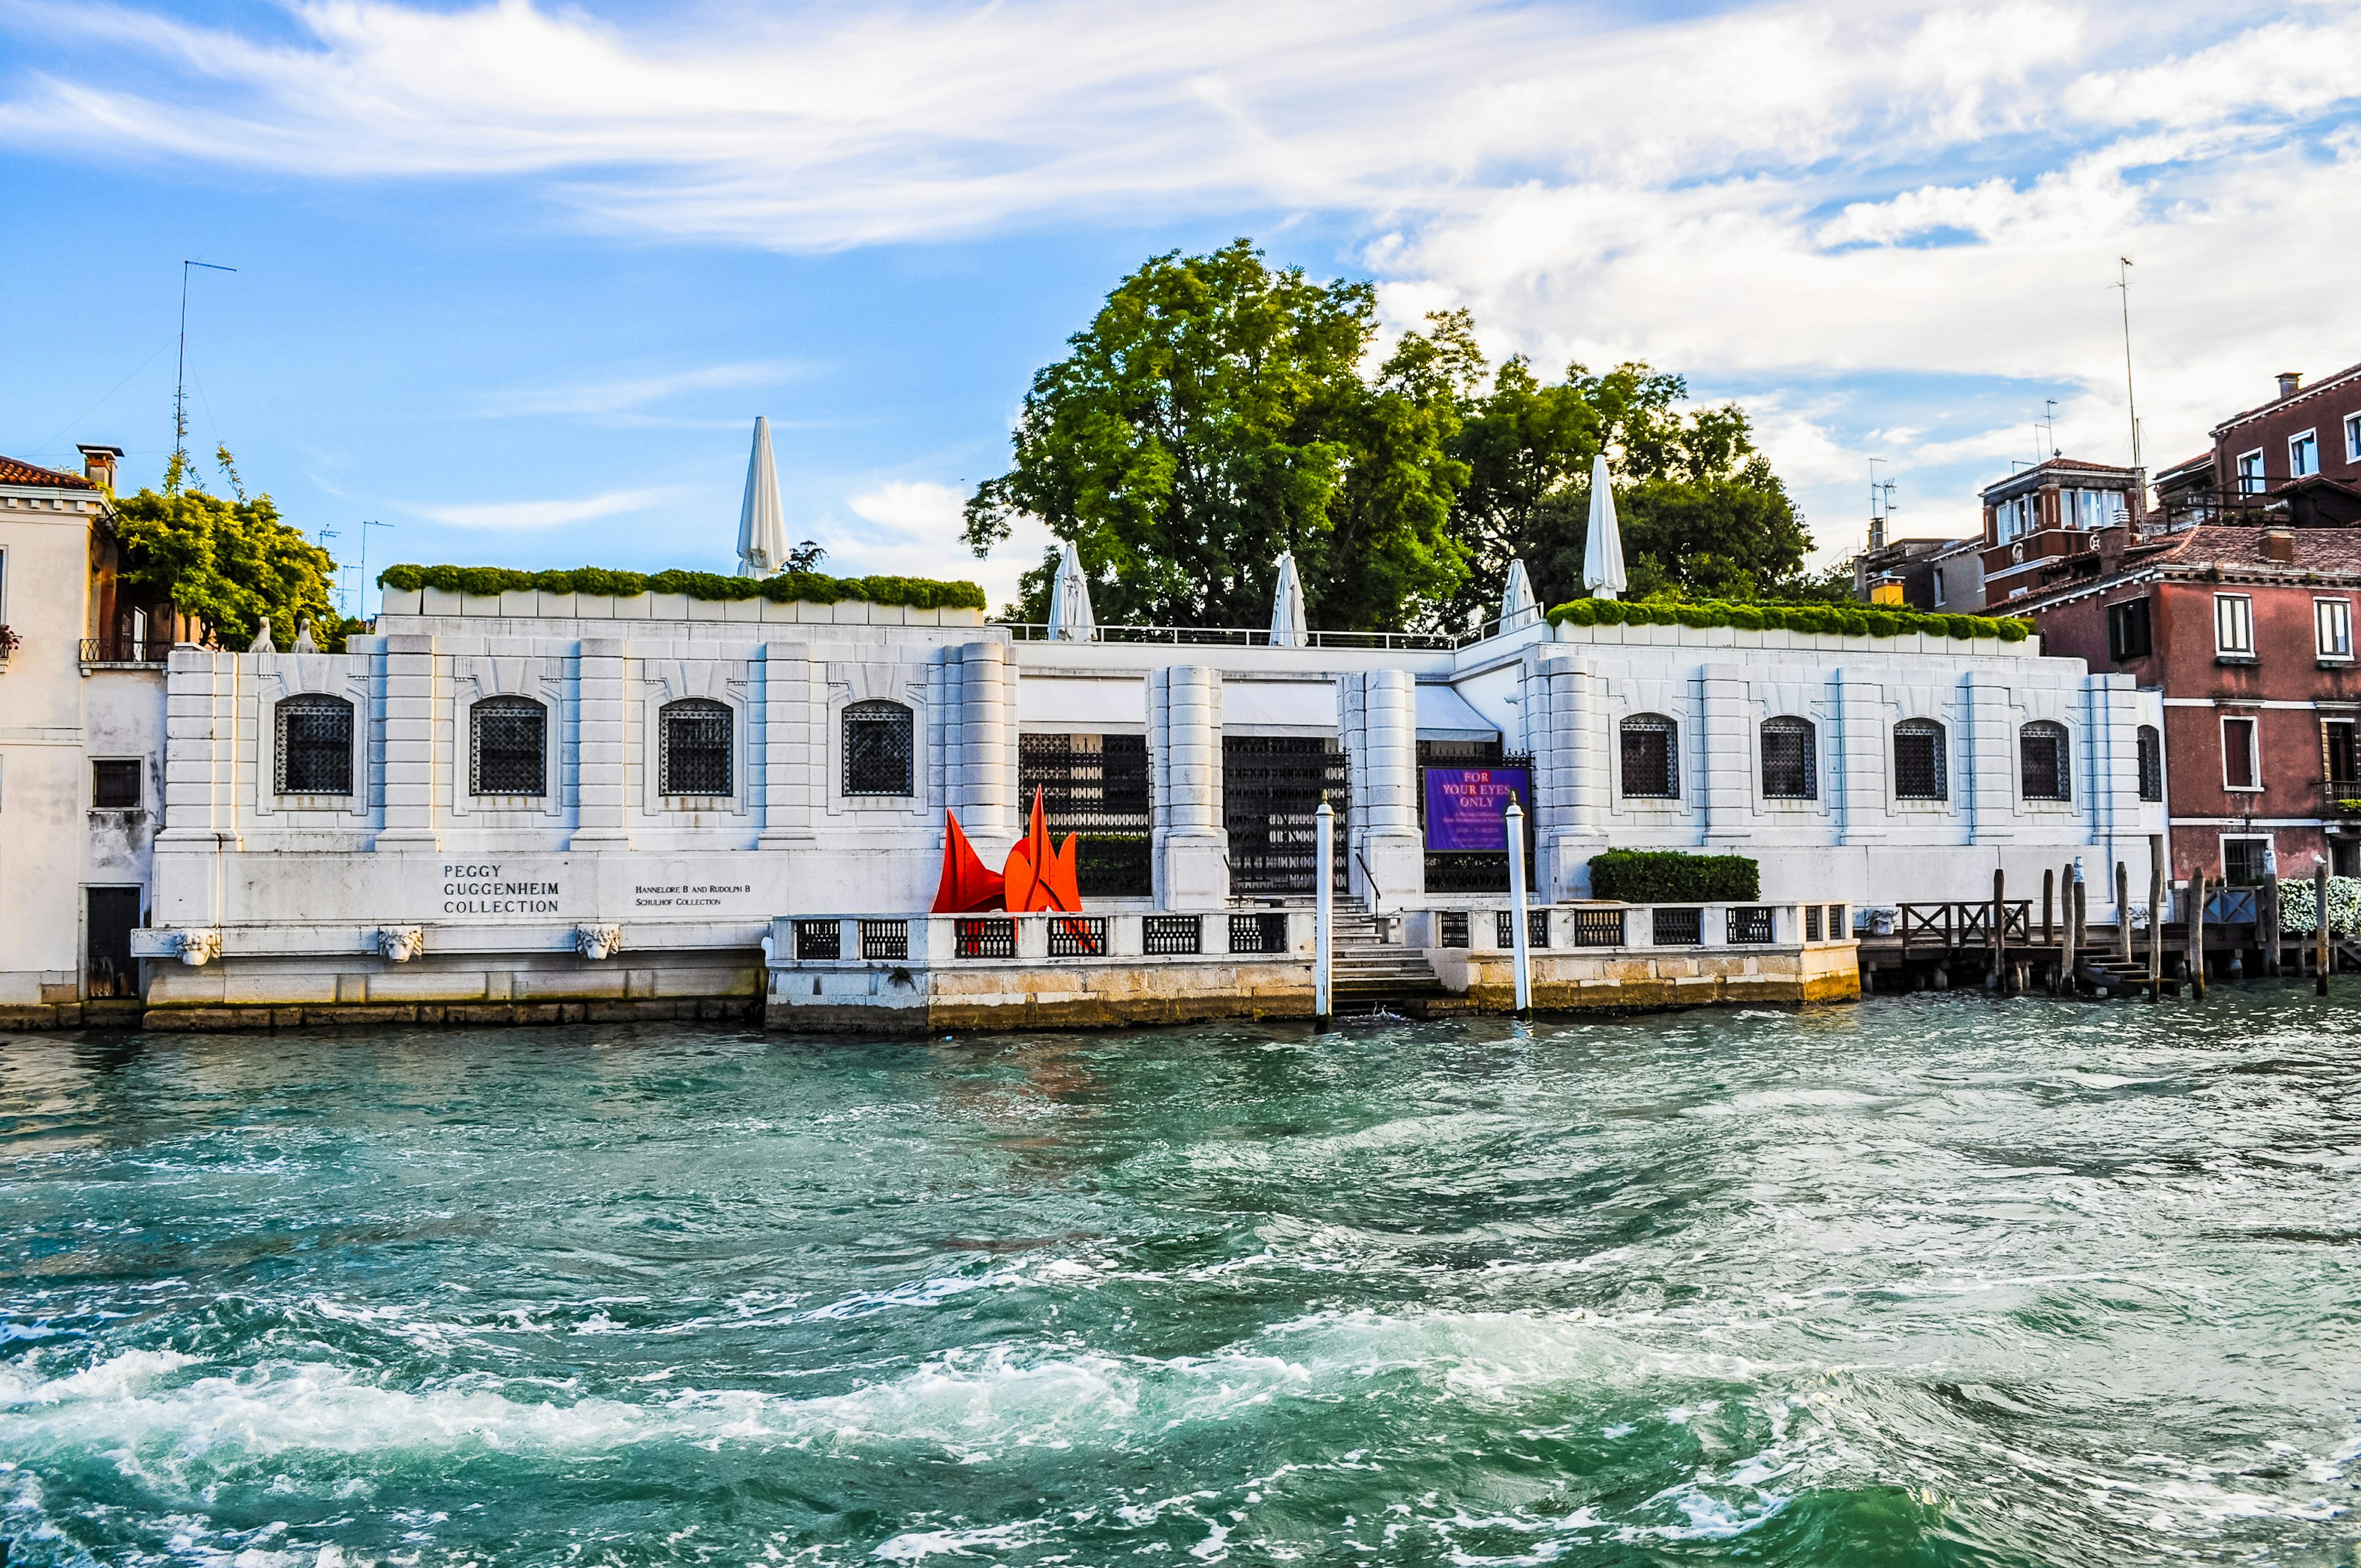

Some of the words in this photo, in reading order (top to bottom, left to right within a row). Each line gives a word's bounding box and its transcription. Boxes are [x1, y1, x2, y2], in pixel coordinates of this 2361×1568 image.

[1465, 772, 1489, 782] FOR
[1443, 785, 1476, 794] YOUR
[1481, 785, 1511, 794] EYES
[1460, 798, 1494, 807] ONLY
[445, 865, 501, 877] PEGGY
[444, 883, 558, 895] GUGGENHEIM
[444, 901, 558, 913] COLLECTION
